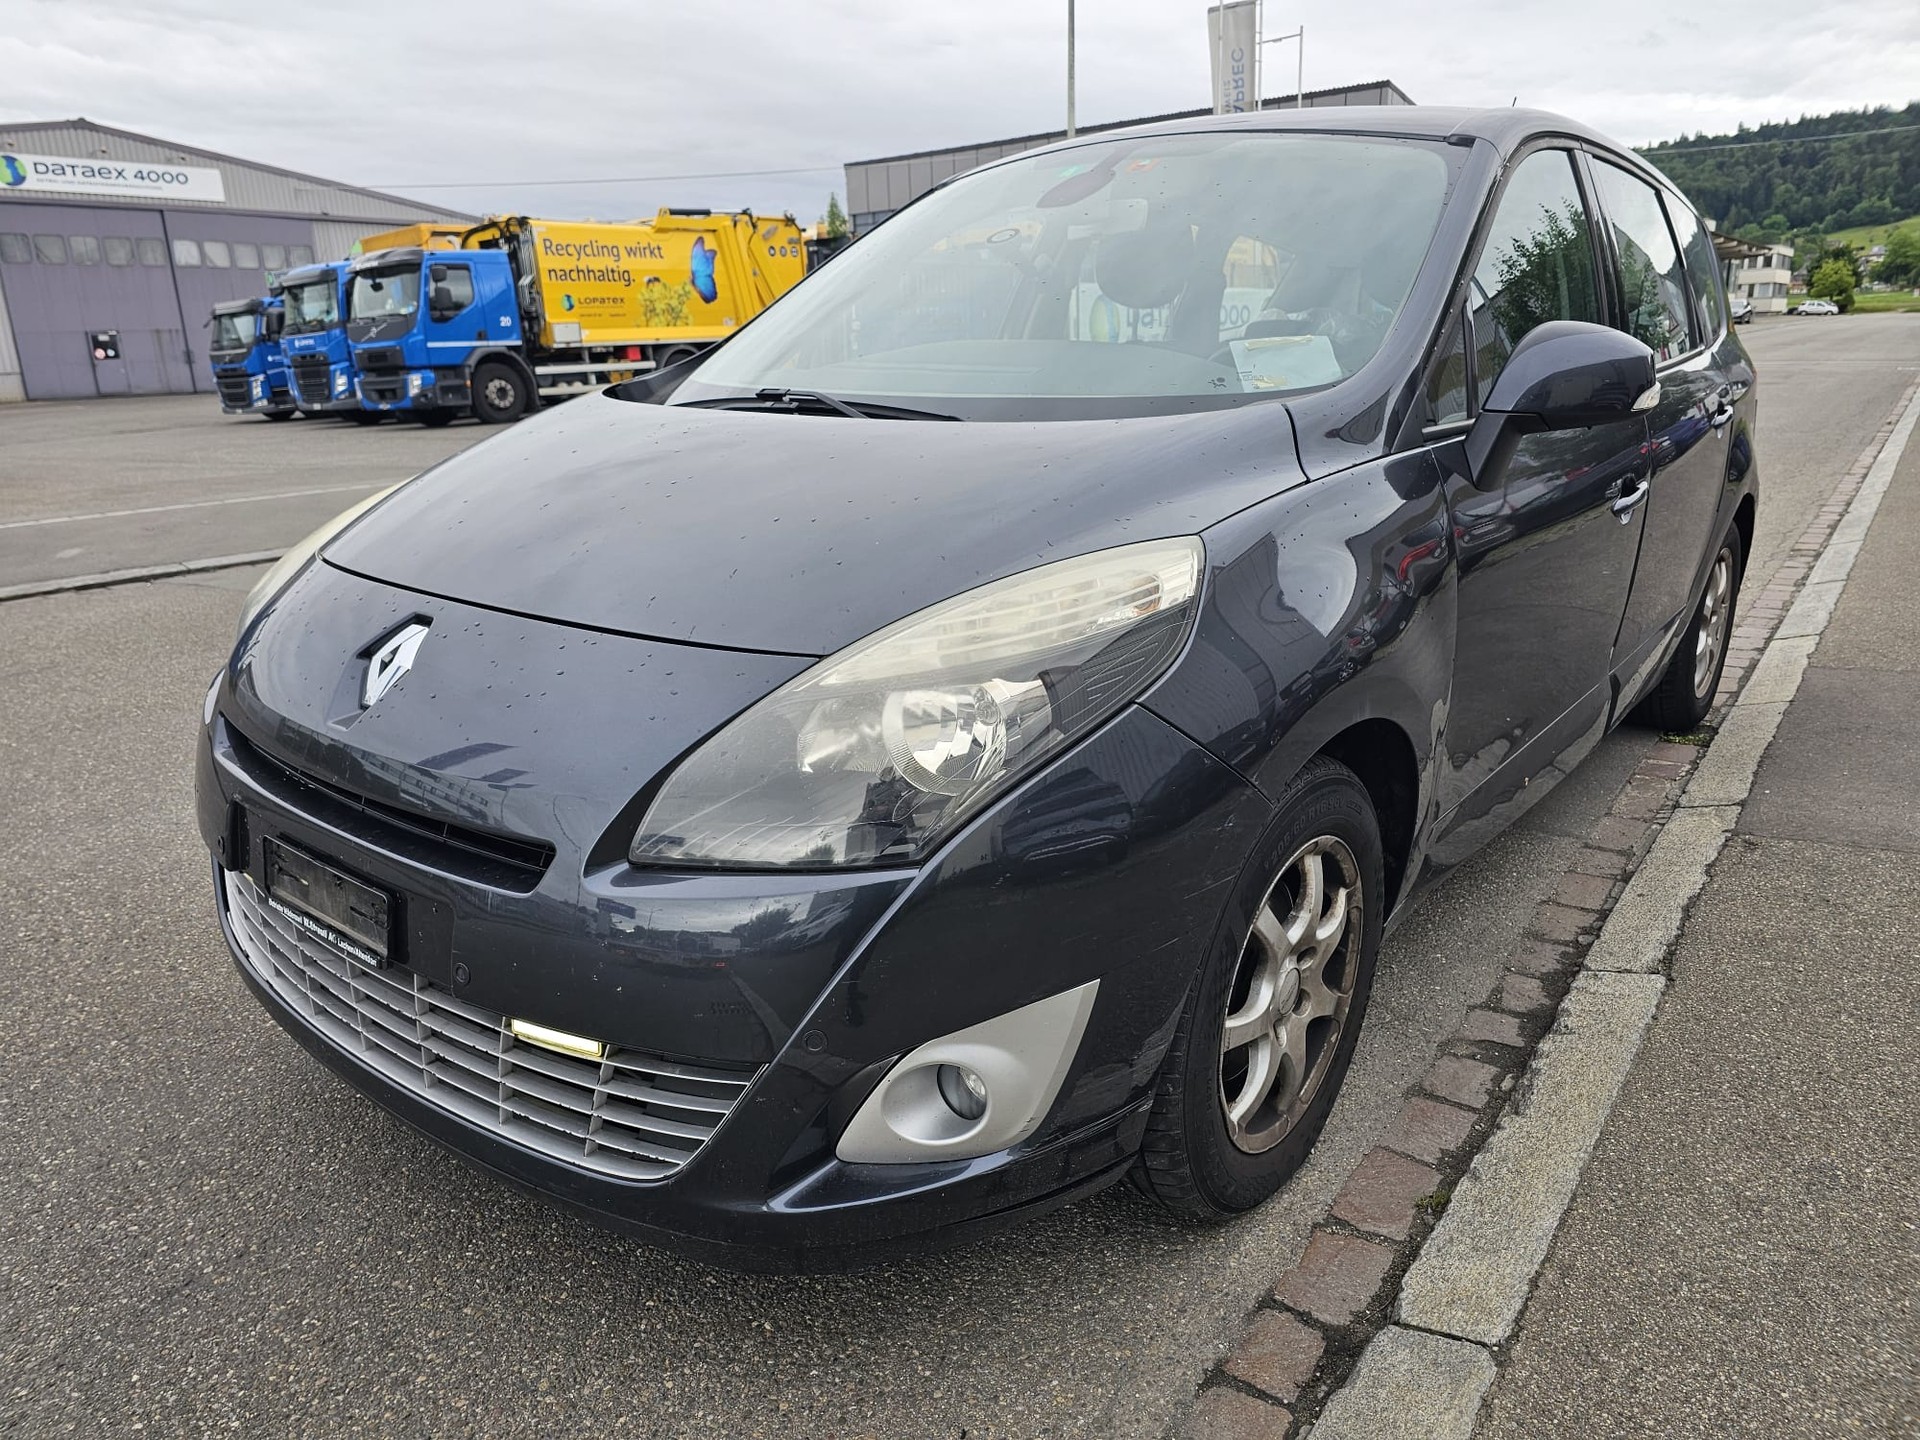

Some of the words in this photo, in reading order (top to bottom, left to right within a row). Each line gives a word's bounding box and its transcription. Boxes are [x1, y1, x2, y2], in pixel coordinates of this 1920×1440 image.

[133, 170, 189, 185] 4000
[543, 238, 621, 262] Recycling
[625, 242, 664, 259] wirkt
[548, 265, 636, 287] nachhaltig.
